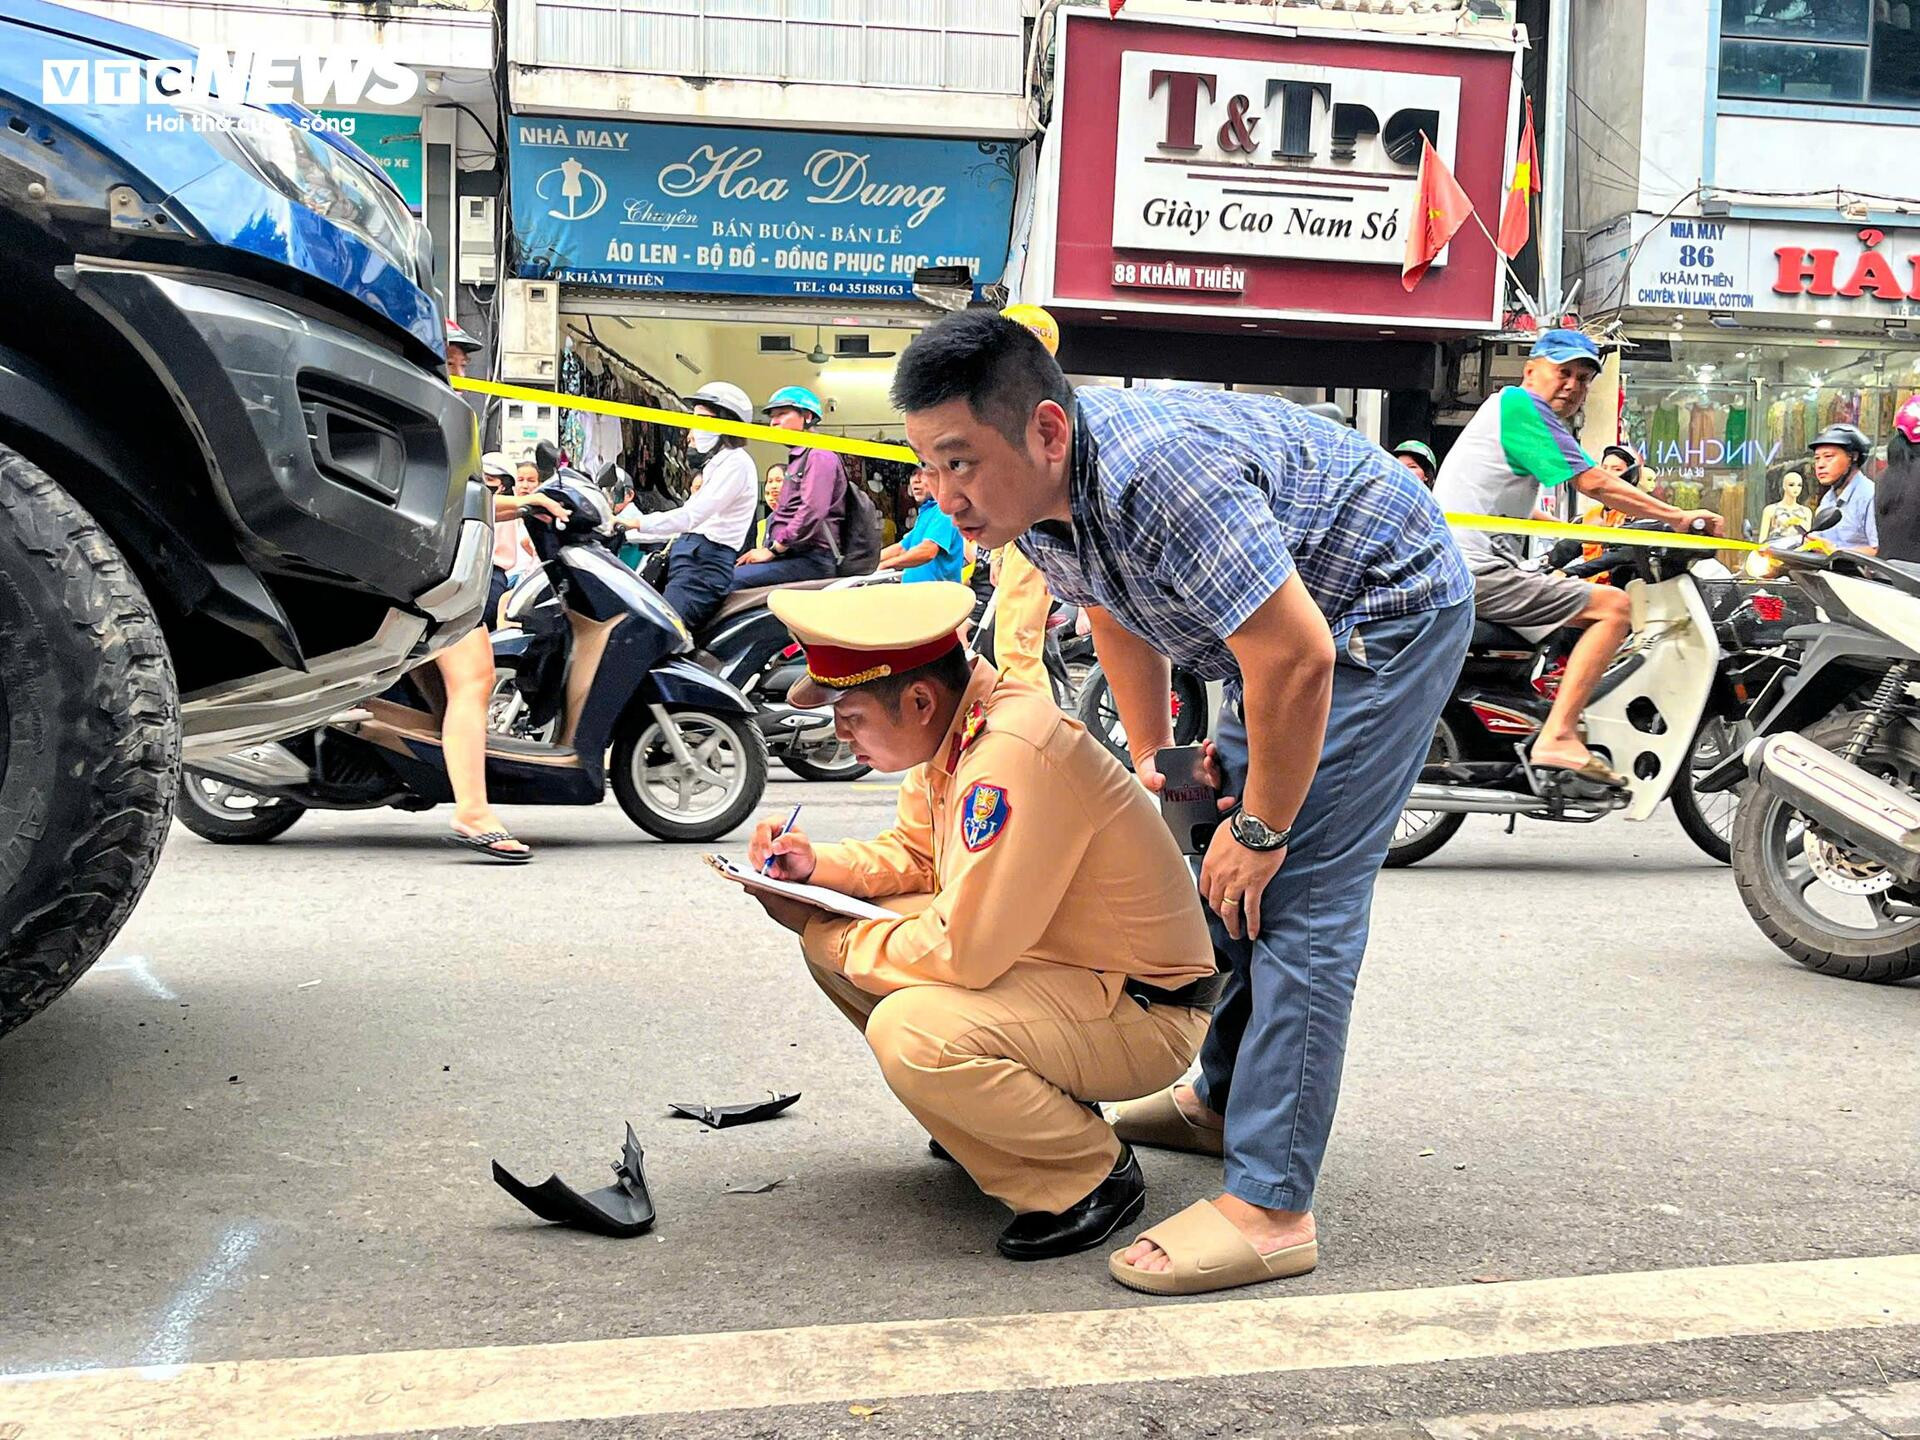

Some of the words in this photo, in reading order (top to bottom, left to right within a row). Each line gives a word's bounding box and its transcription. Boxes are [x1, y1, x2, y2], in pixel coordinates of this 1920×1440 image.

[519, 124, 569, 145] NHÀ
[576, 129, 629, 148] MAY
[394, 158, 410, 168] XE
[657, 144, 790, 201] Hoa
[803, 148, 947, 229] Dung
[622, 198, 699, 232] Chuyên
[1142, 197, 1210, 236] Giày
[1219, 202, 1274, 233] Cao
[1284, 207, 1353, 239] Nam
[1361, 208, 1400, 241] Số
[711, 217, 753, 238] BÁN
[759, 221, 814, 241] BUÔN
[831, 223, 873, 243] BÁN
[877, 225, 903, 244] LẺ
[1670, 219, 1694, 239] NHÀ
[1697, 223, 1726, 240] MAY
[606, 238, 633, 263] ÁO
[639, 243, 677, 265] LEN
[696, 242, 724, 271] BỘ
[728, 241, 756, 268] ĐỒ
[775, 244, 828, 271] ĐỒNG
[834, 252, 885, 277] PHỤC
[890, 254, 930, 278] HỌC
[1679, 244, 1715, 267] 86
[565, 270, 613, 285] KHÂM
[616, 272, 665, 286] THIÊN
[1114, 264, 1137, 284] 88
[1140, 262, 1191, 287] KHÂM
[1194, 266, 1245, 289] THIÊN
[1659, 272, 1699, 286] KHÂM
[1701, 272, 1734, 288] THIÊN
[793, 281, 826, 293] TEL:
[828, 282, 845, 294] 04
[846, 282, 905, 295] 35188163
[1718, 294, 1754, 308] COTTON
[963, 817, 998, 833] CSGT
